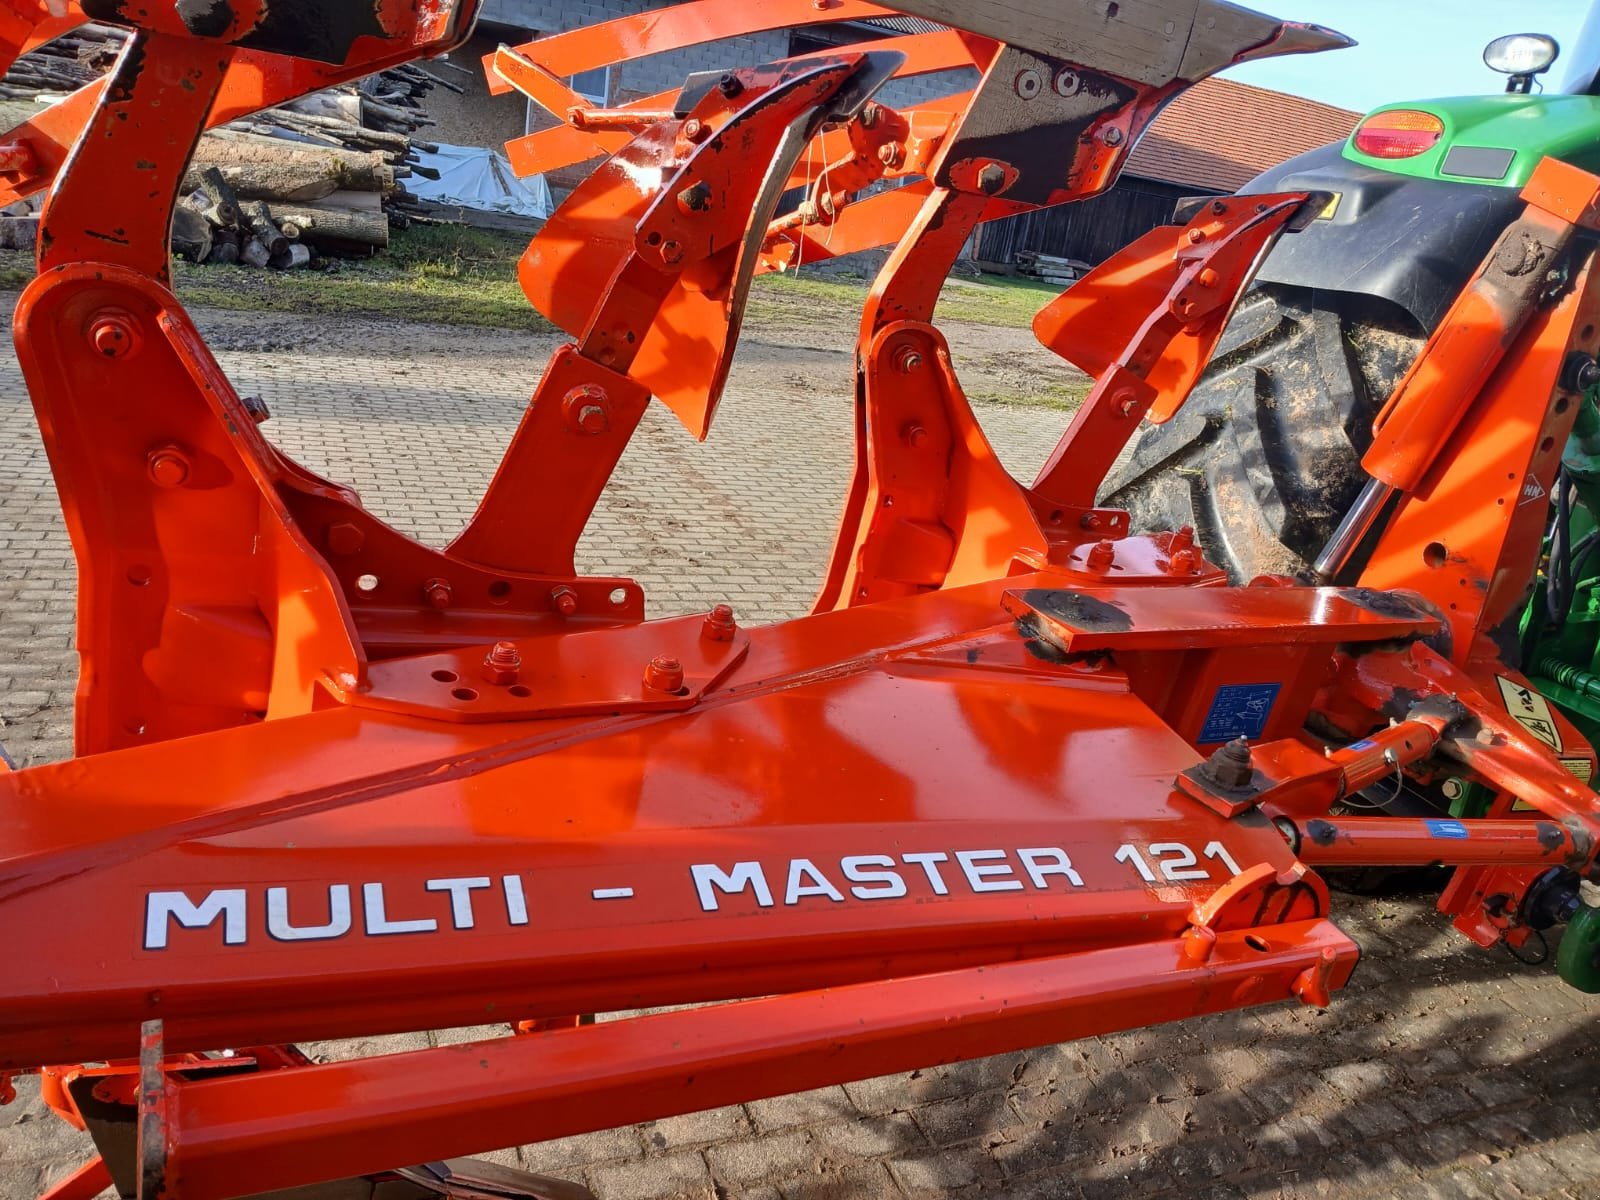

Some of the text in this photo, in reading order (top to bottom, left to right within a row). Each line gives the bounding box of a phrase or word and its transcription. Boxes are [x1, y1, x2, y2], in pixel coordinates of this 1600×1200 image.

[144, 841, 1243, 950] MULTI - MASTER 121
